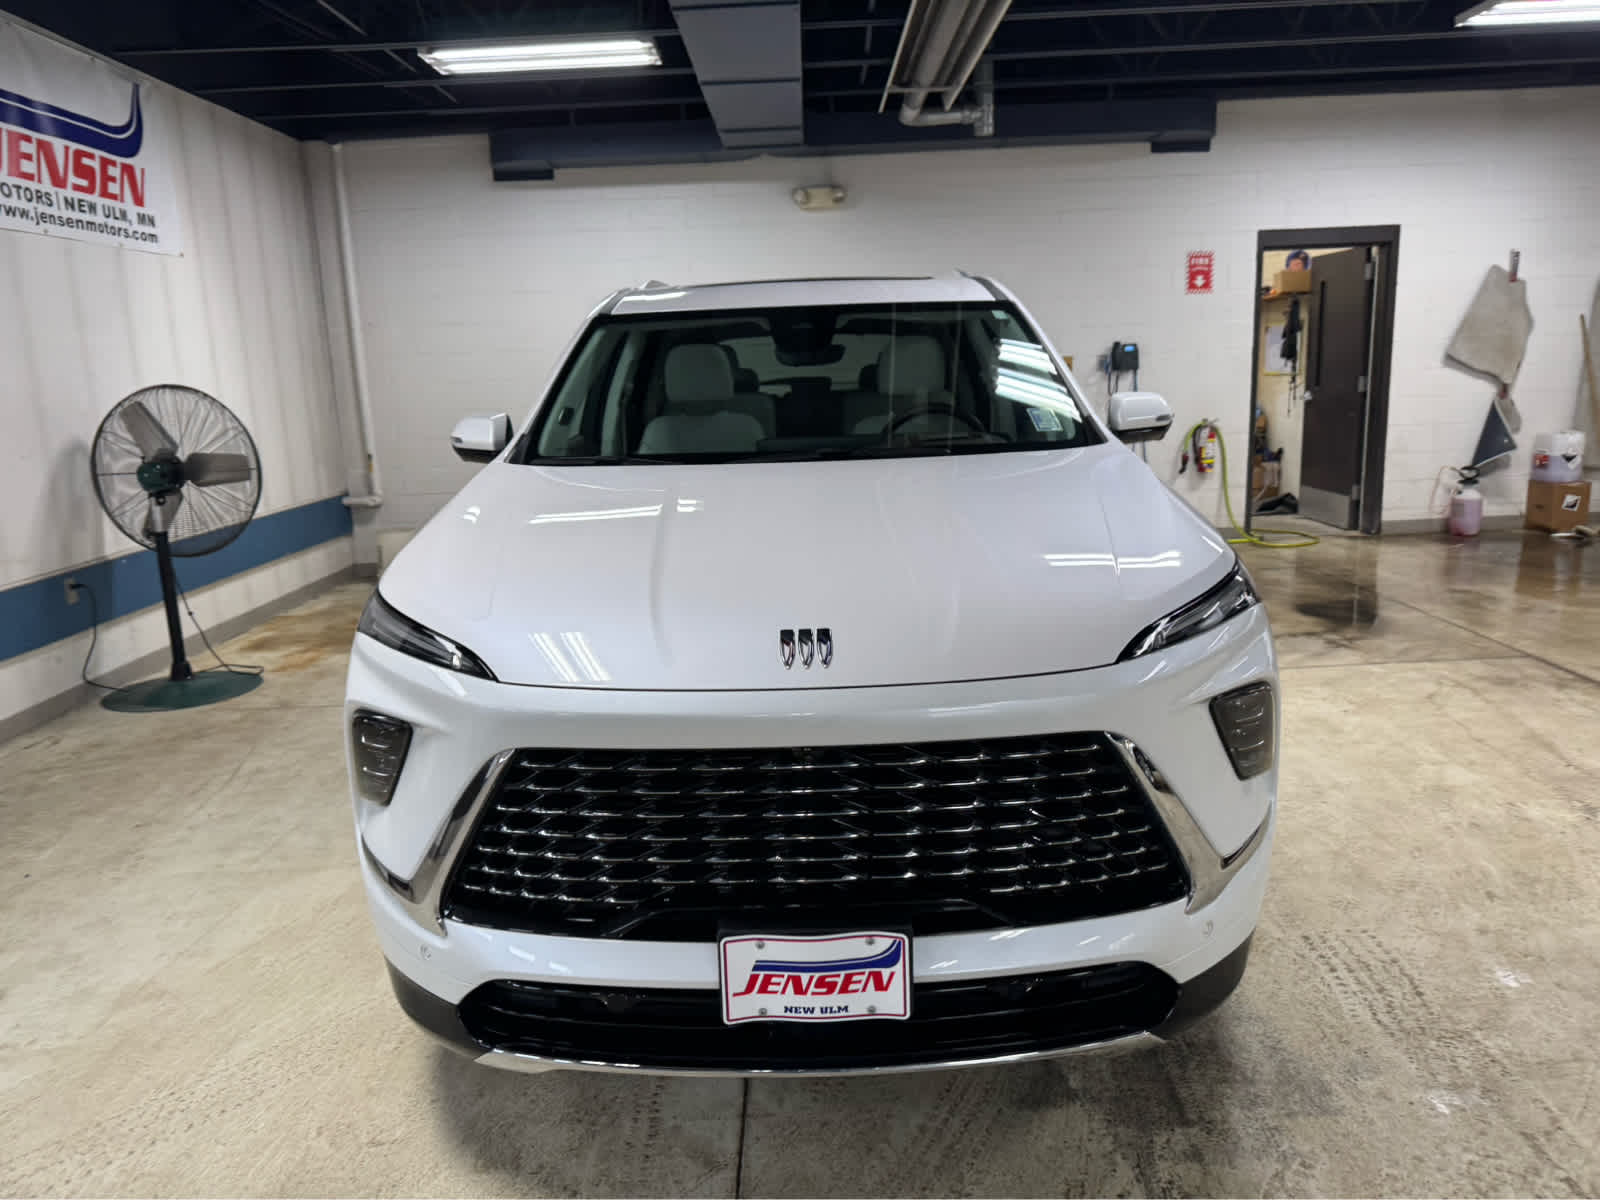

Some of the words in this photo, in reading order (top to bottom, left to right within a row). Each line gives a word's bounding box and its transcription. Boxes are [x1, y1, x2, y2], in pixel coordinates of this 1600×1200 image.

[63, 196, 98, 215] NEW
[102, 204, 133, 226] ULM,
[136, 212, 156, 228] MN
[732, 971, 896, 997] JENSEN
[783, 1005, 815, 1014] NEW
[819, 1005, 849, 1014] ULM
